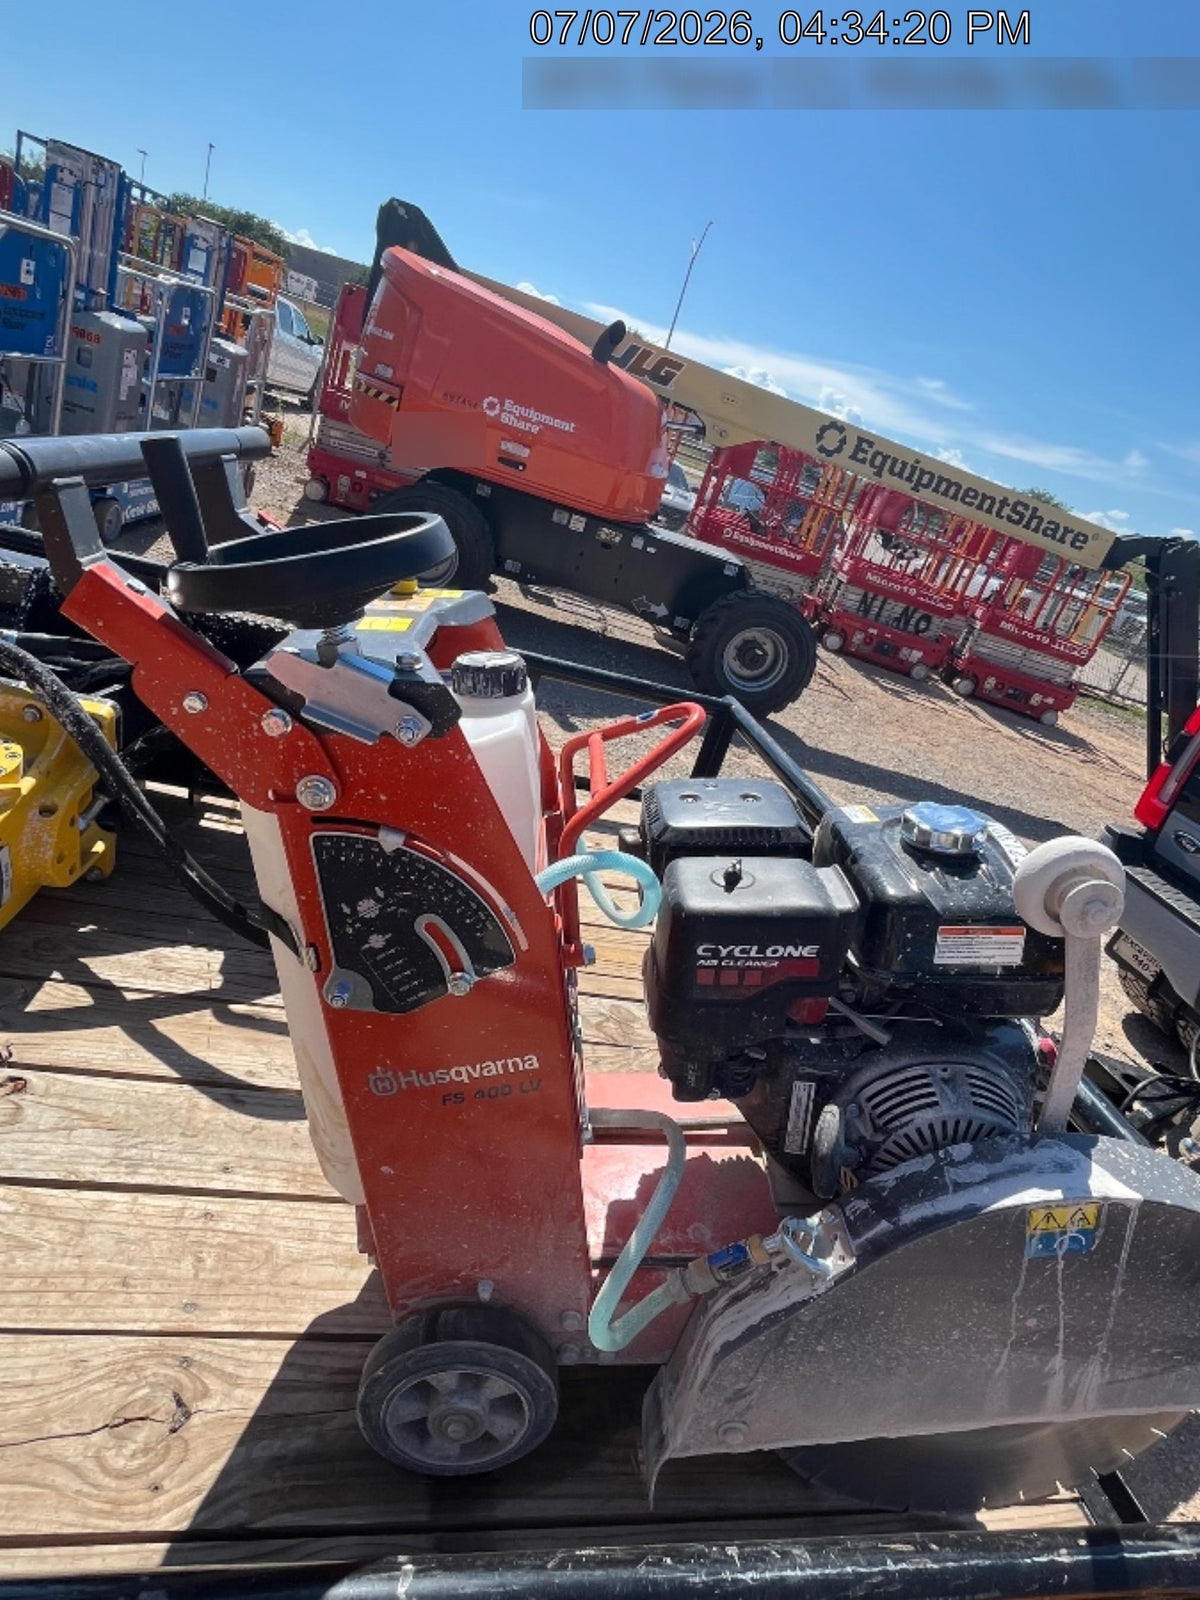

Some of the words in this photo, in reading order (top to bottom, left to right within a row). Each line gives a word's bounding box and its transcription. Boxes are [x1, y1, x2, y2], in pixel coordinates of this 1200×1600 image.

[608, 343, 687, 390] JLG
[500, 411, 540, 435] Share
[502, 399, 577, 433] Equipment
[696, 944, 821, 959] CYCLONE
[721, 958, 780, 969] CLEANER
[400, 1053, 541, 1090] Husqvarna
[441, 1091, 466, 1107] FS
[473, 1084, 513, 1101] 400
